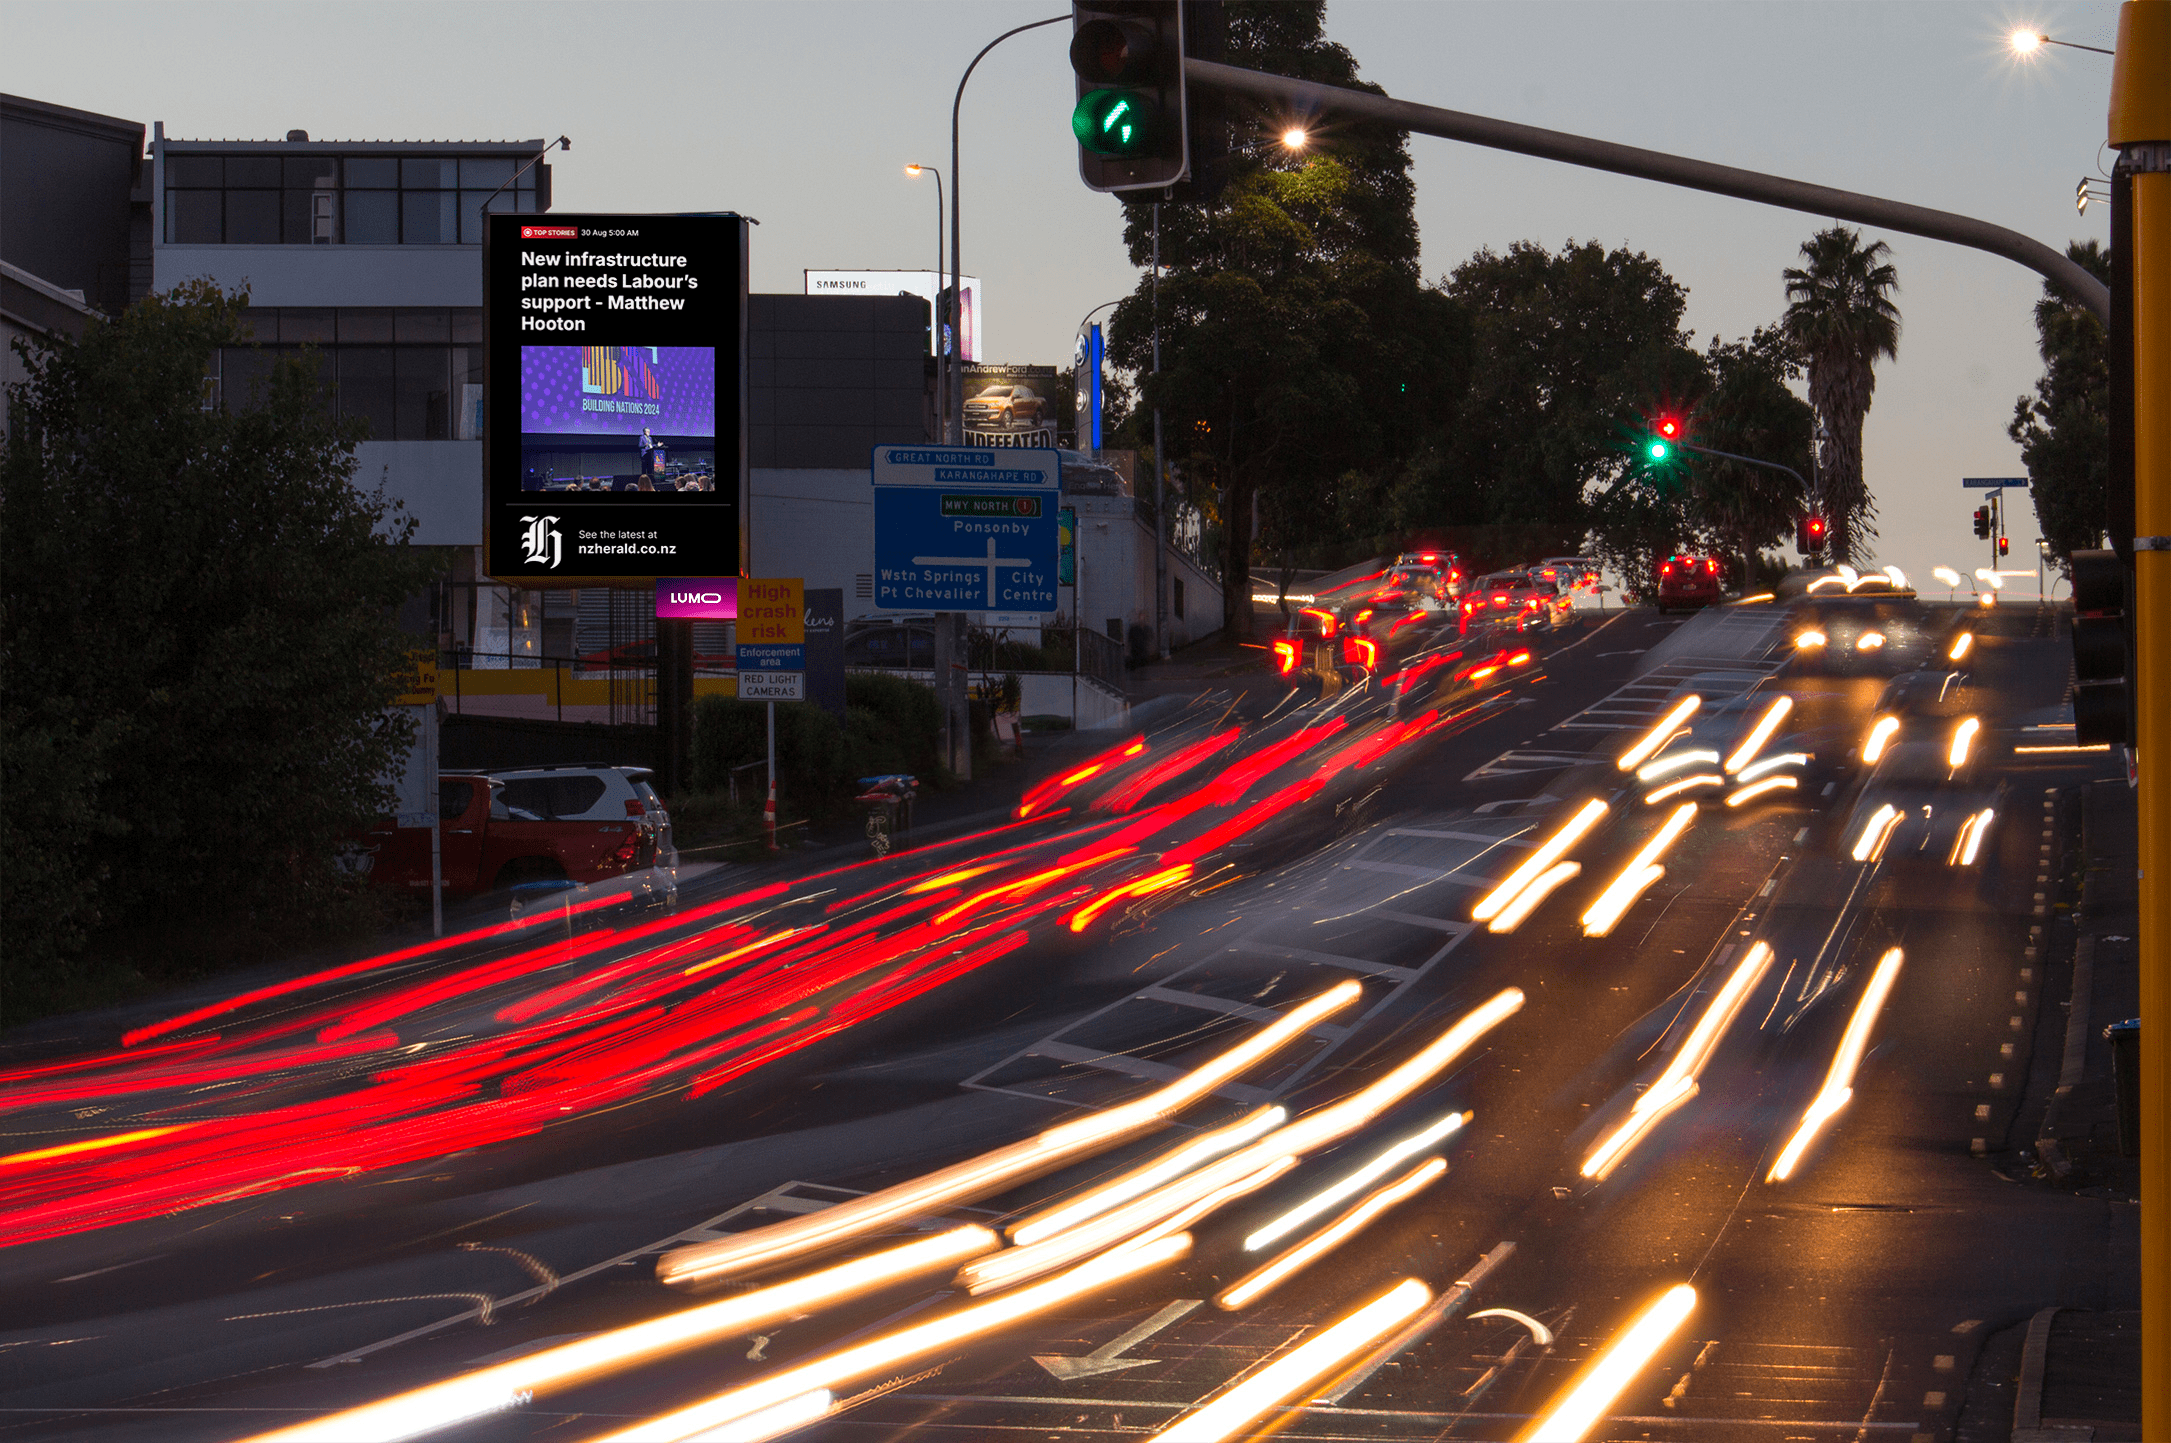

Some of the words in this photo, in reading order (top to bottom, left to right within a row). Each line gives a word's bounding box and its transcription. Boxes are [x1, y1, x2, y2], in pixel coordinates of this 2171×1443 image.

[592, 229, 607, 238] Aug
[521, 251, 561, 267] New
[565, 251, 687, 267] infrastructure
[521, 273, 559, 291] plan
[564, 273, 618, 289] needs
[816, 280, 867, 289] SAMSUNG
[521, 295, 591, 313] support
[608, 295, 685, 310] Matthew
[521, 316, 586, 331] Hooton
[582, 398, 614, 413] BUILDING
[615, 401, 643, 414] NATIONS
[643, 403, 660, 415] 2024
[895, 452, 931, 463] GREAT
[935, 453, 971, 464] NORTH
[974, 454, 989, 464] RD
[940, 470, 1019, 482] KARANGAHAPE
[1023, 472, 1037, 482] RD
[945, 500, 969, 510] MWY
[974, 501, 1009, 511] NORTH
[578, 530, 597, 539] See
[600, 530, 616, 539] the
[618, 530, 645, 539] latest
[647, 530, 658, 539] at
[954, 520, 1030, 536] Ponsonby
[578, 543, 677, 555] nzherald.co.nz
[880, 569, 917, 582] Wstn
[923, 570, 981, 586] Springs
[1011, 571, 1044, 587] City
[670, 592, 722, 604] LUMO
[748, 584, 791, 602] High
[880, 586, 898, 598] Pt
[904, 586, 981, 599] Chevalier
[1003, 588, 1053, 601] Centre
[743, 604, 797, 618] crash
[752, 623, 787, 638] risk
[740, 647, 801, 657] Enforcement
[759, 658, 781, 667] area
[744, 675, 764, 684] RED
[769, 675, 797, 685] LIGHT
[746, 687, 796, 697] CAMERAS
